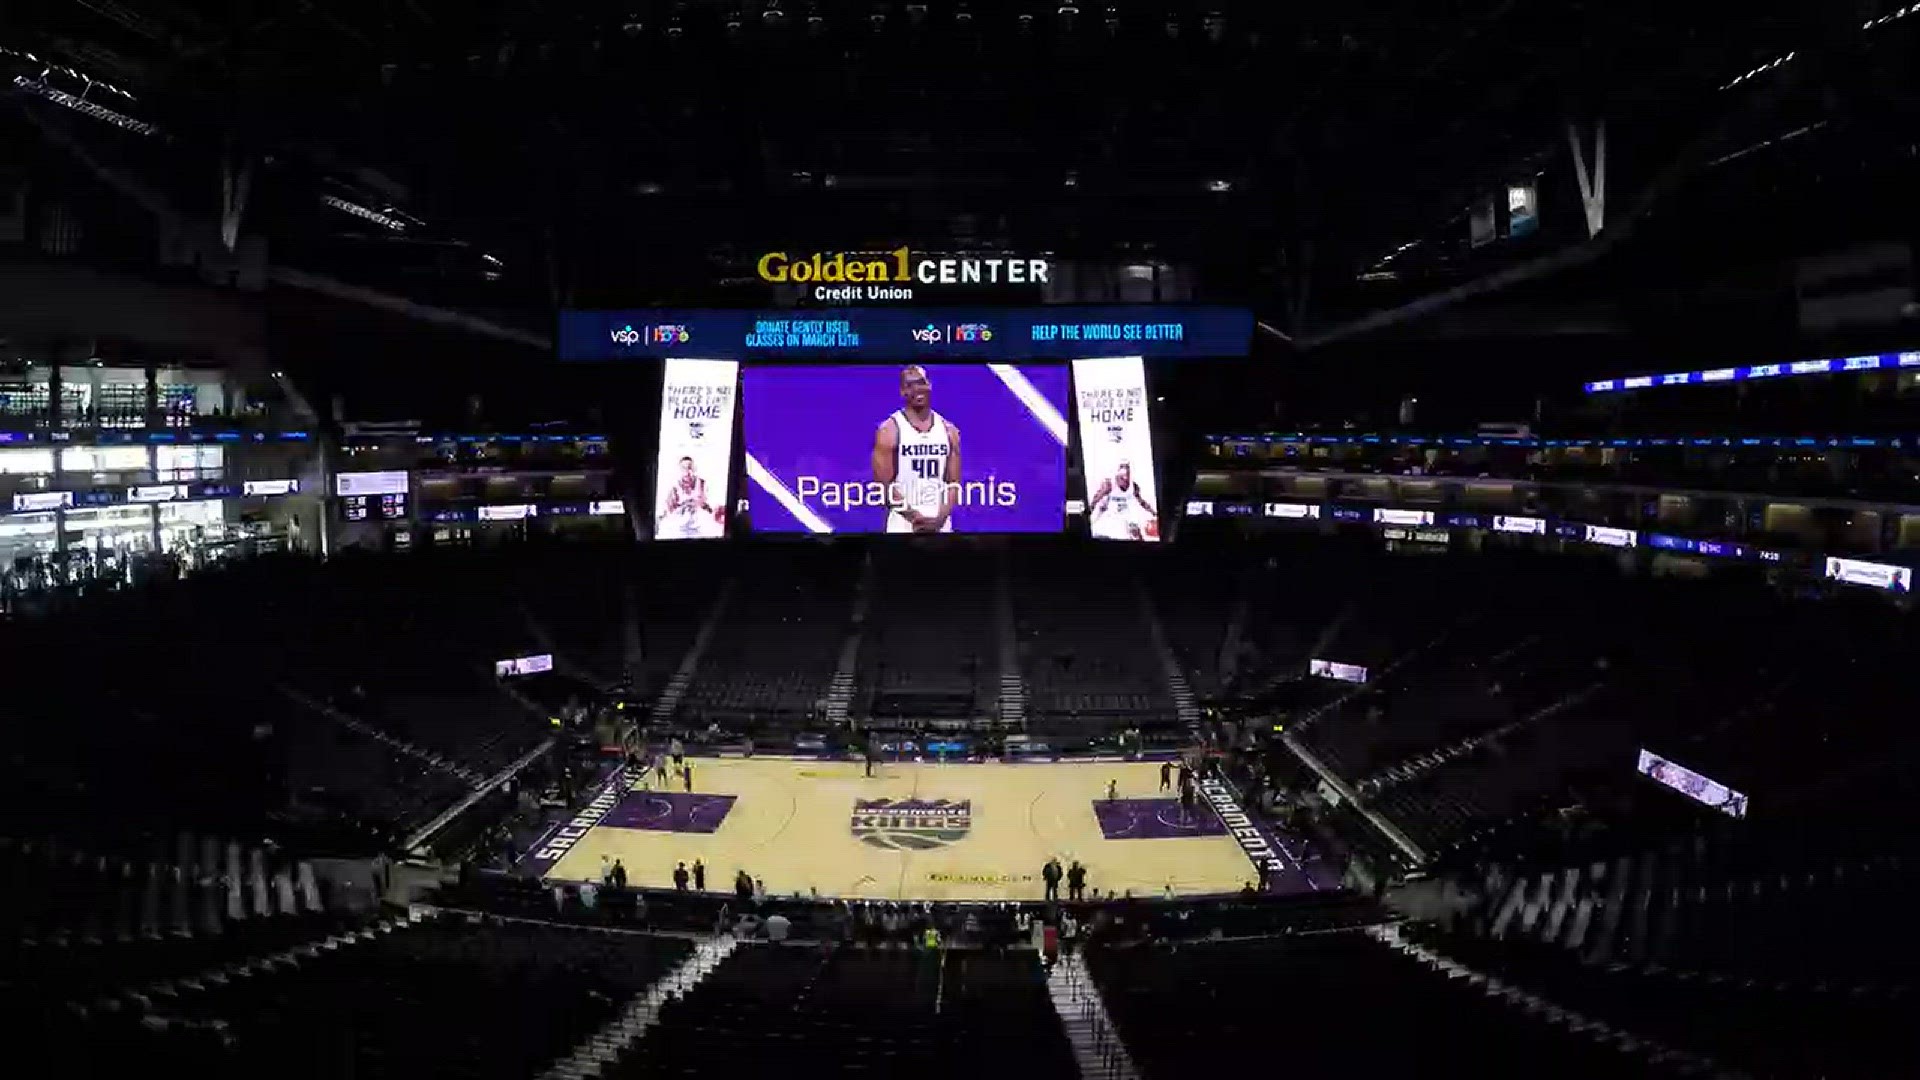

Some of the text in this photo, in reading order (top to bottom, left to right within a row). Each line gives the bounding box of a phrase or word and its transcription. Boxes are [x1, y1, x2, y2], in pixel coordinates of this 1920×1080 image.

[918, 259, 1048, 284] CENTER
[814, 286, 912, 300] Credit Union
[755, 321, 850, 333] DONATE GENTLY USED
[1032, 323, 1183, 341] HELP THE WORLD SEE BETTER
[611, 328, 639, 346] vsp
[787, 333, 799, 346] ON
[802, 333, 835, 346] MARCH
[912, 328, 941, 344] vsp
[673, 406, 720, 419] HOME
[1091, 408, 1133, 423] HOME
[900, 443, 949, 457] KINGS
[911, 459, 939, 479] 40
[796, 475, 1018, 512] Papagiannis
[850, 816, 972, 830] KINGS
